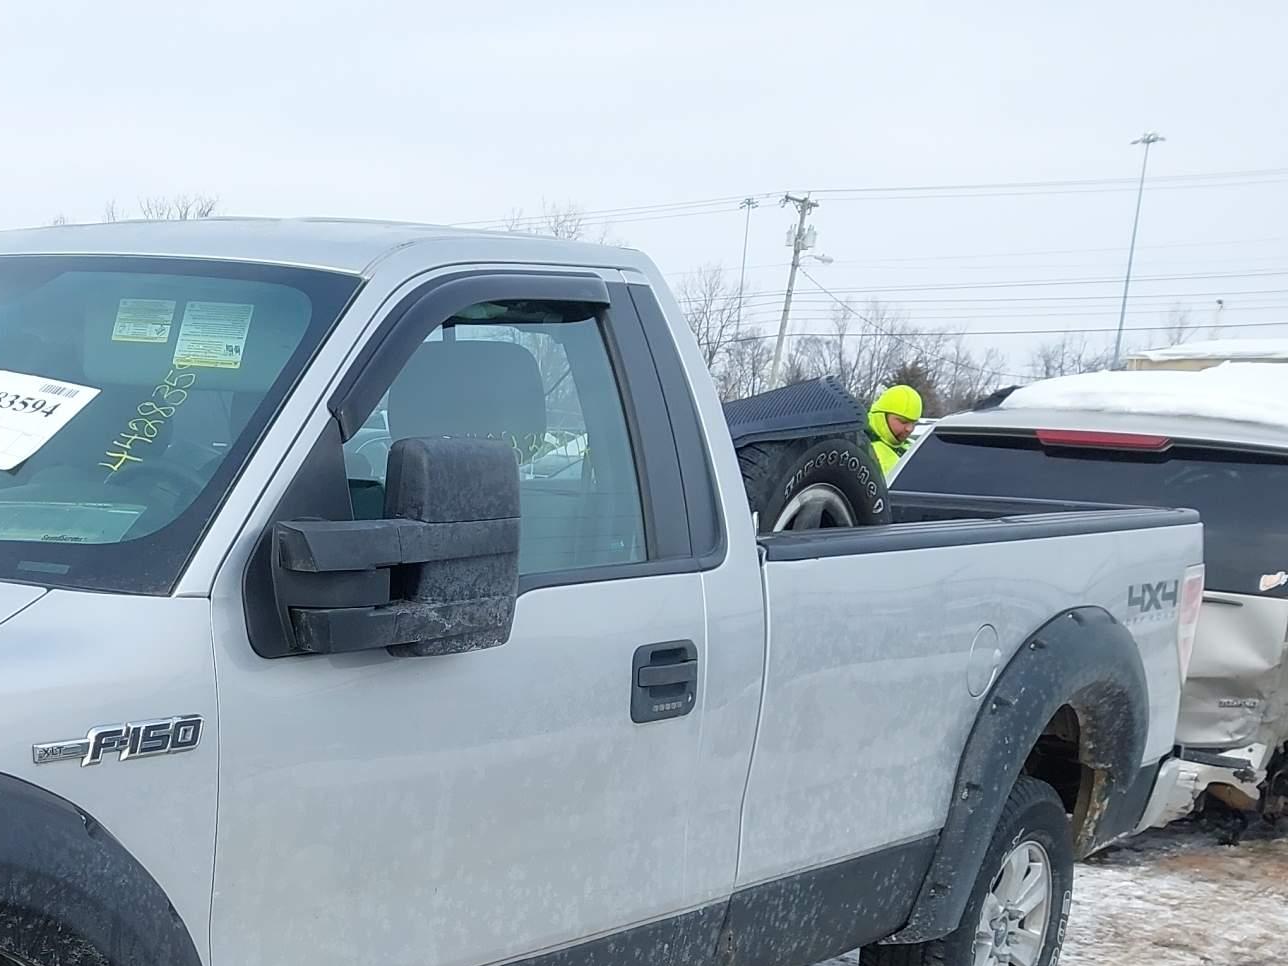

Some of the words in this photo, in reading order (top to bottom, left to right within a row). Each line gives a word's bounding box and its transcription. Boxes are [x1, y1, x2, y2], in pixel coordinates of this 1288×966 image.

[1128, 580, 1179, 612] 4X4
[43, 746, 64, 757] XLT
[81, 714, 204, 767] F-150
